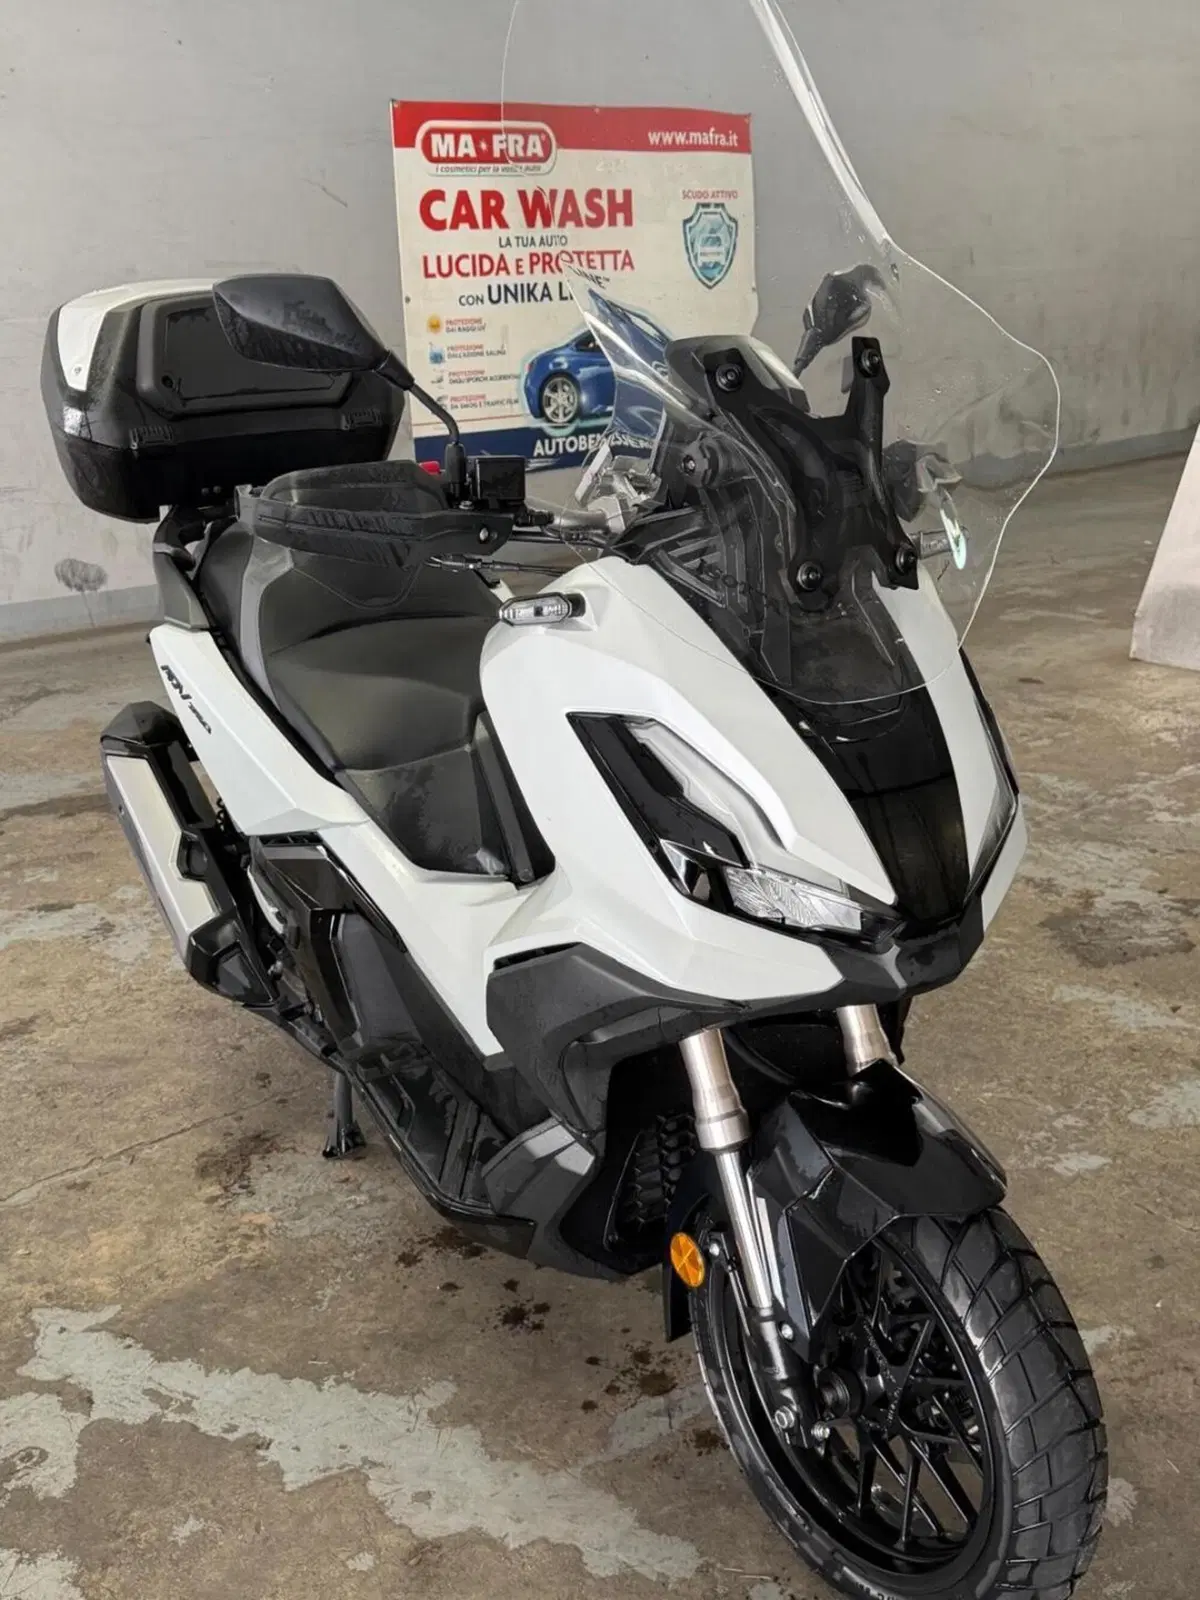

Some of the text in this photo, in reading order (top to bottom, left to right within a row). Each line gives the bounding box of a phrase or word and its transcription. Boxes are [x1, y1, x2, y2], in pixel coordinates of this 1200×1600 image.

[648, 126, 738, 147] www.mafra.it
[682, 190, 738, 200] SCUDO ATTIVO
[419, 186, 633, 231] CAR WASH
[499, 235, 568, 248] LA TUA AUTO
[423, 249, 635, 279] LUCIDA E PROTETTA
[458, 295, 485, 307] CON
[487, 282, 553, 305] UNIKA
